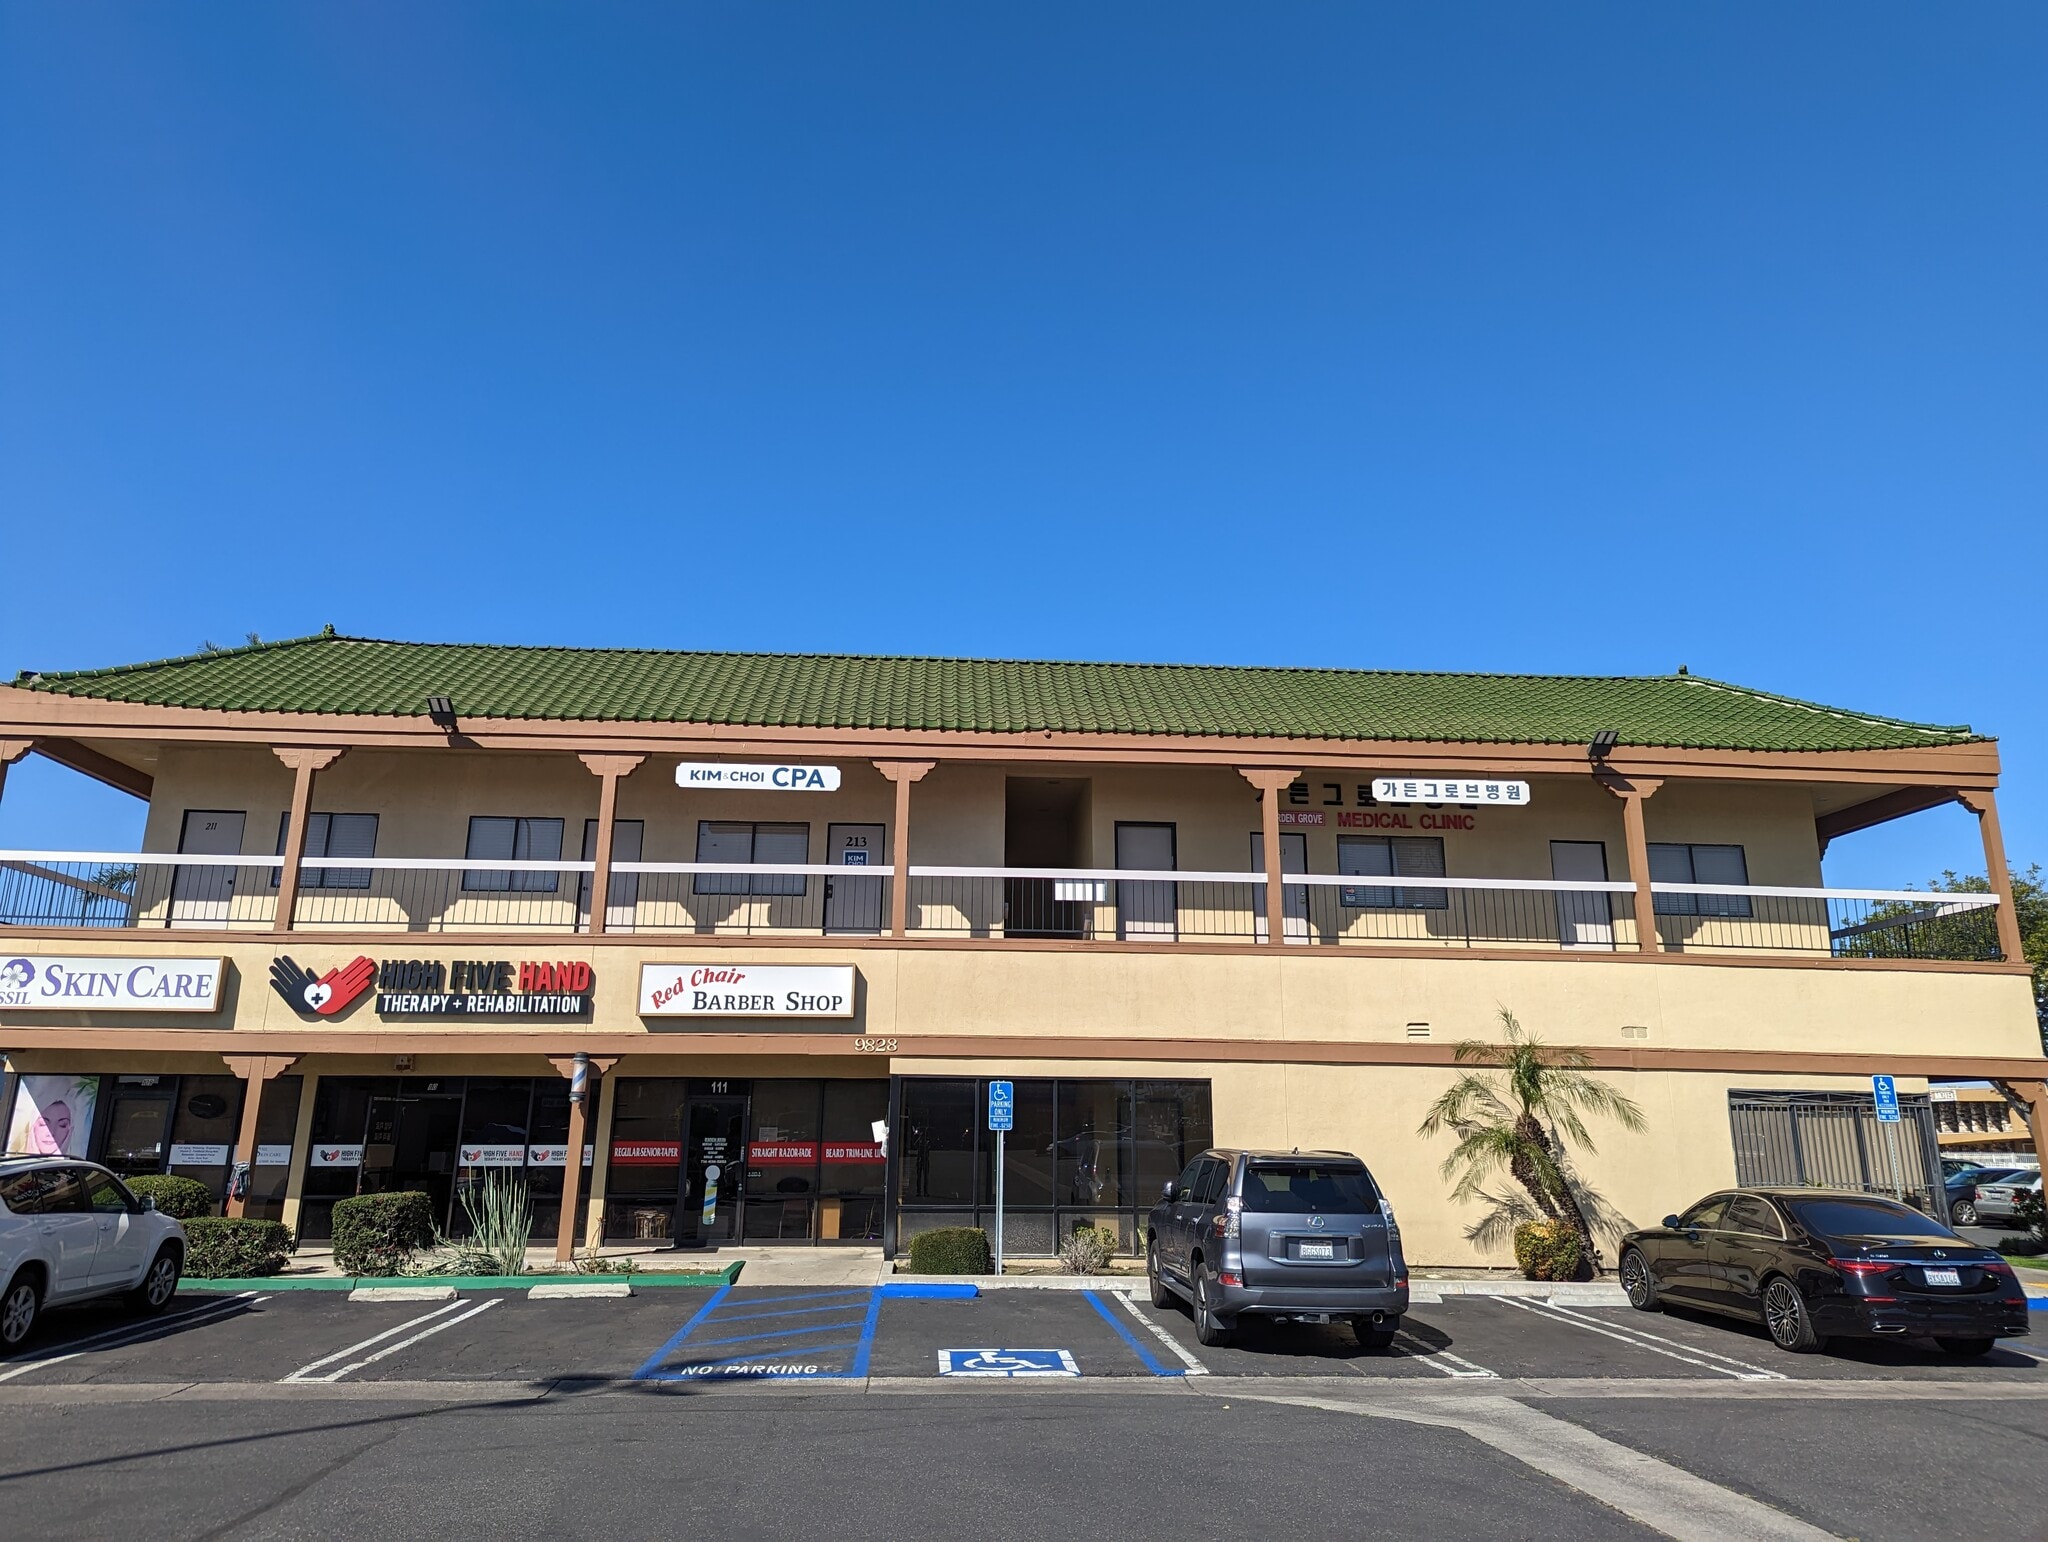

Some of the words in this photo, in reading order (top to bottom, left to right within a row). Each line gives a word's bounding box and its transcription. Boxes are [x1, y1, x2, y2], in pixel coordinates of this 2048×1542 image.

[690, 769, 722, 781] KIM
[730, 771, 764, 782] CHOI
[772, 767, 825, 788] CPA
[1382, 781, 1521, 800] 가든그로브병원
[1297, 813, 1323, 824] GROVE
[1337, 812, 1413, 829] MEDICAL
[1420, 813, 1475, 830] CLINIC
[205, 822, 218, 831] 211
[845, 836, 867, 847] 213
[378, 959, 441, 990] HIGH
[449, 960, 511, 991] FIVE
[518, 961, 592, 991] HAND
[651, 976, 684, 1010] Red
[690, 967, 746, 987] Chair
[383, 995, 449, 1012] THERAPY
[466, 995, 580, 1013] REHABILITATION
[692, 991, 775, 1011] BARBER
[785, 991, 843, 1012] SHOP
[854, 1038, 898, 1052] 9828
[711, 1081, 728, 1094] 111
[991, 1100, 1011, 1108] PARKING
[994, 1108, 1007, 1116] ONLY
[751, 1148, 778, 1158] STRAIGHT
[825, 1148, 845, 1158] BEARD
[846, 1148, 873, 1158] TRIM-LINE
[681, 1365, 713, 1375] NO
[724, 1365, 819, 1375] PARKING
